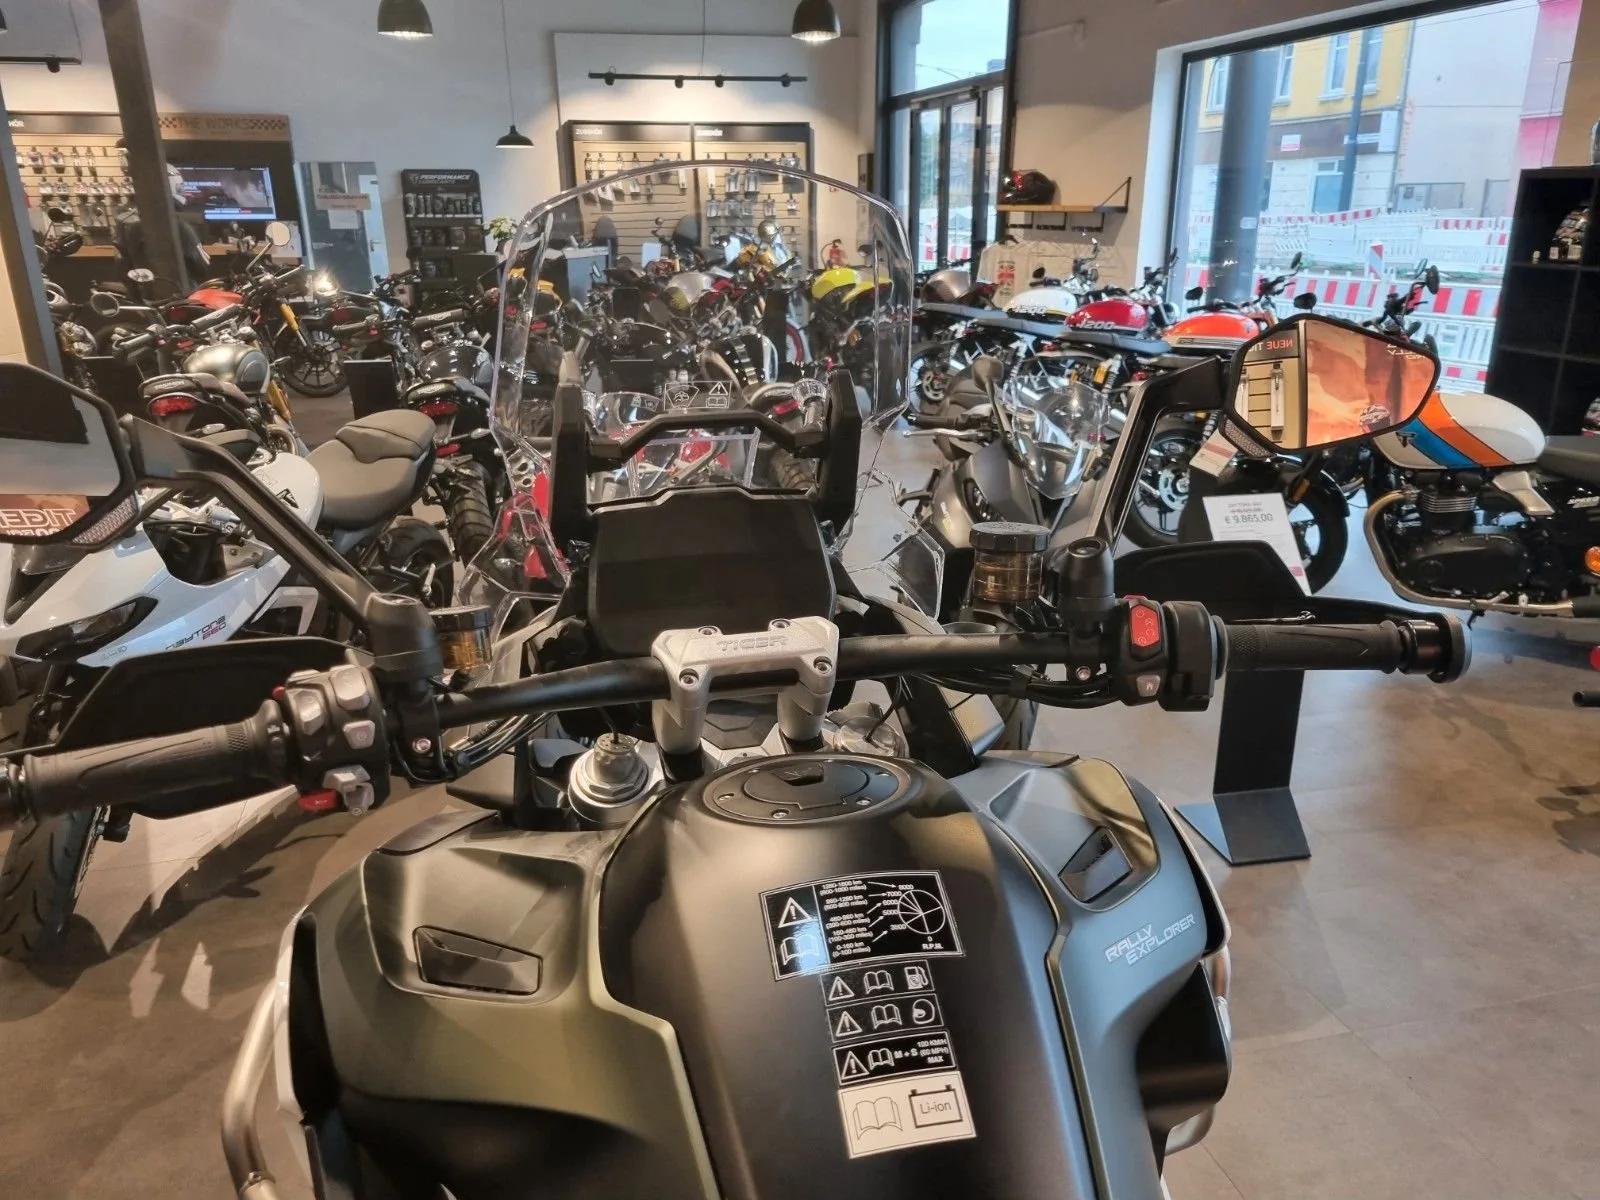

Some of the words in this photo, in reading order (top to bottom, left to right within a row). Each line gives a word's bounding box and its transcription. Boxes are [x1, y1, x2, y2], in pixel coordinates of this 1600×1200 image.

[717, 635, 787, 651] TIGER
[1104, 924, 1152, 962] RALLY
[1125, 914, 1195, 965] EXPLORER
[893, 1050, 903, 1059] M
[911, 1048, 918, 1056] S
[920, 1102, 952, 1114] Li-ion
